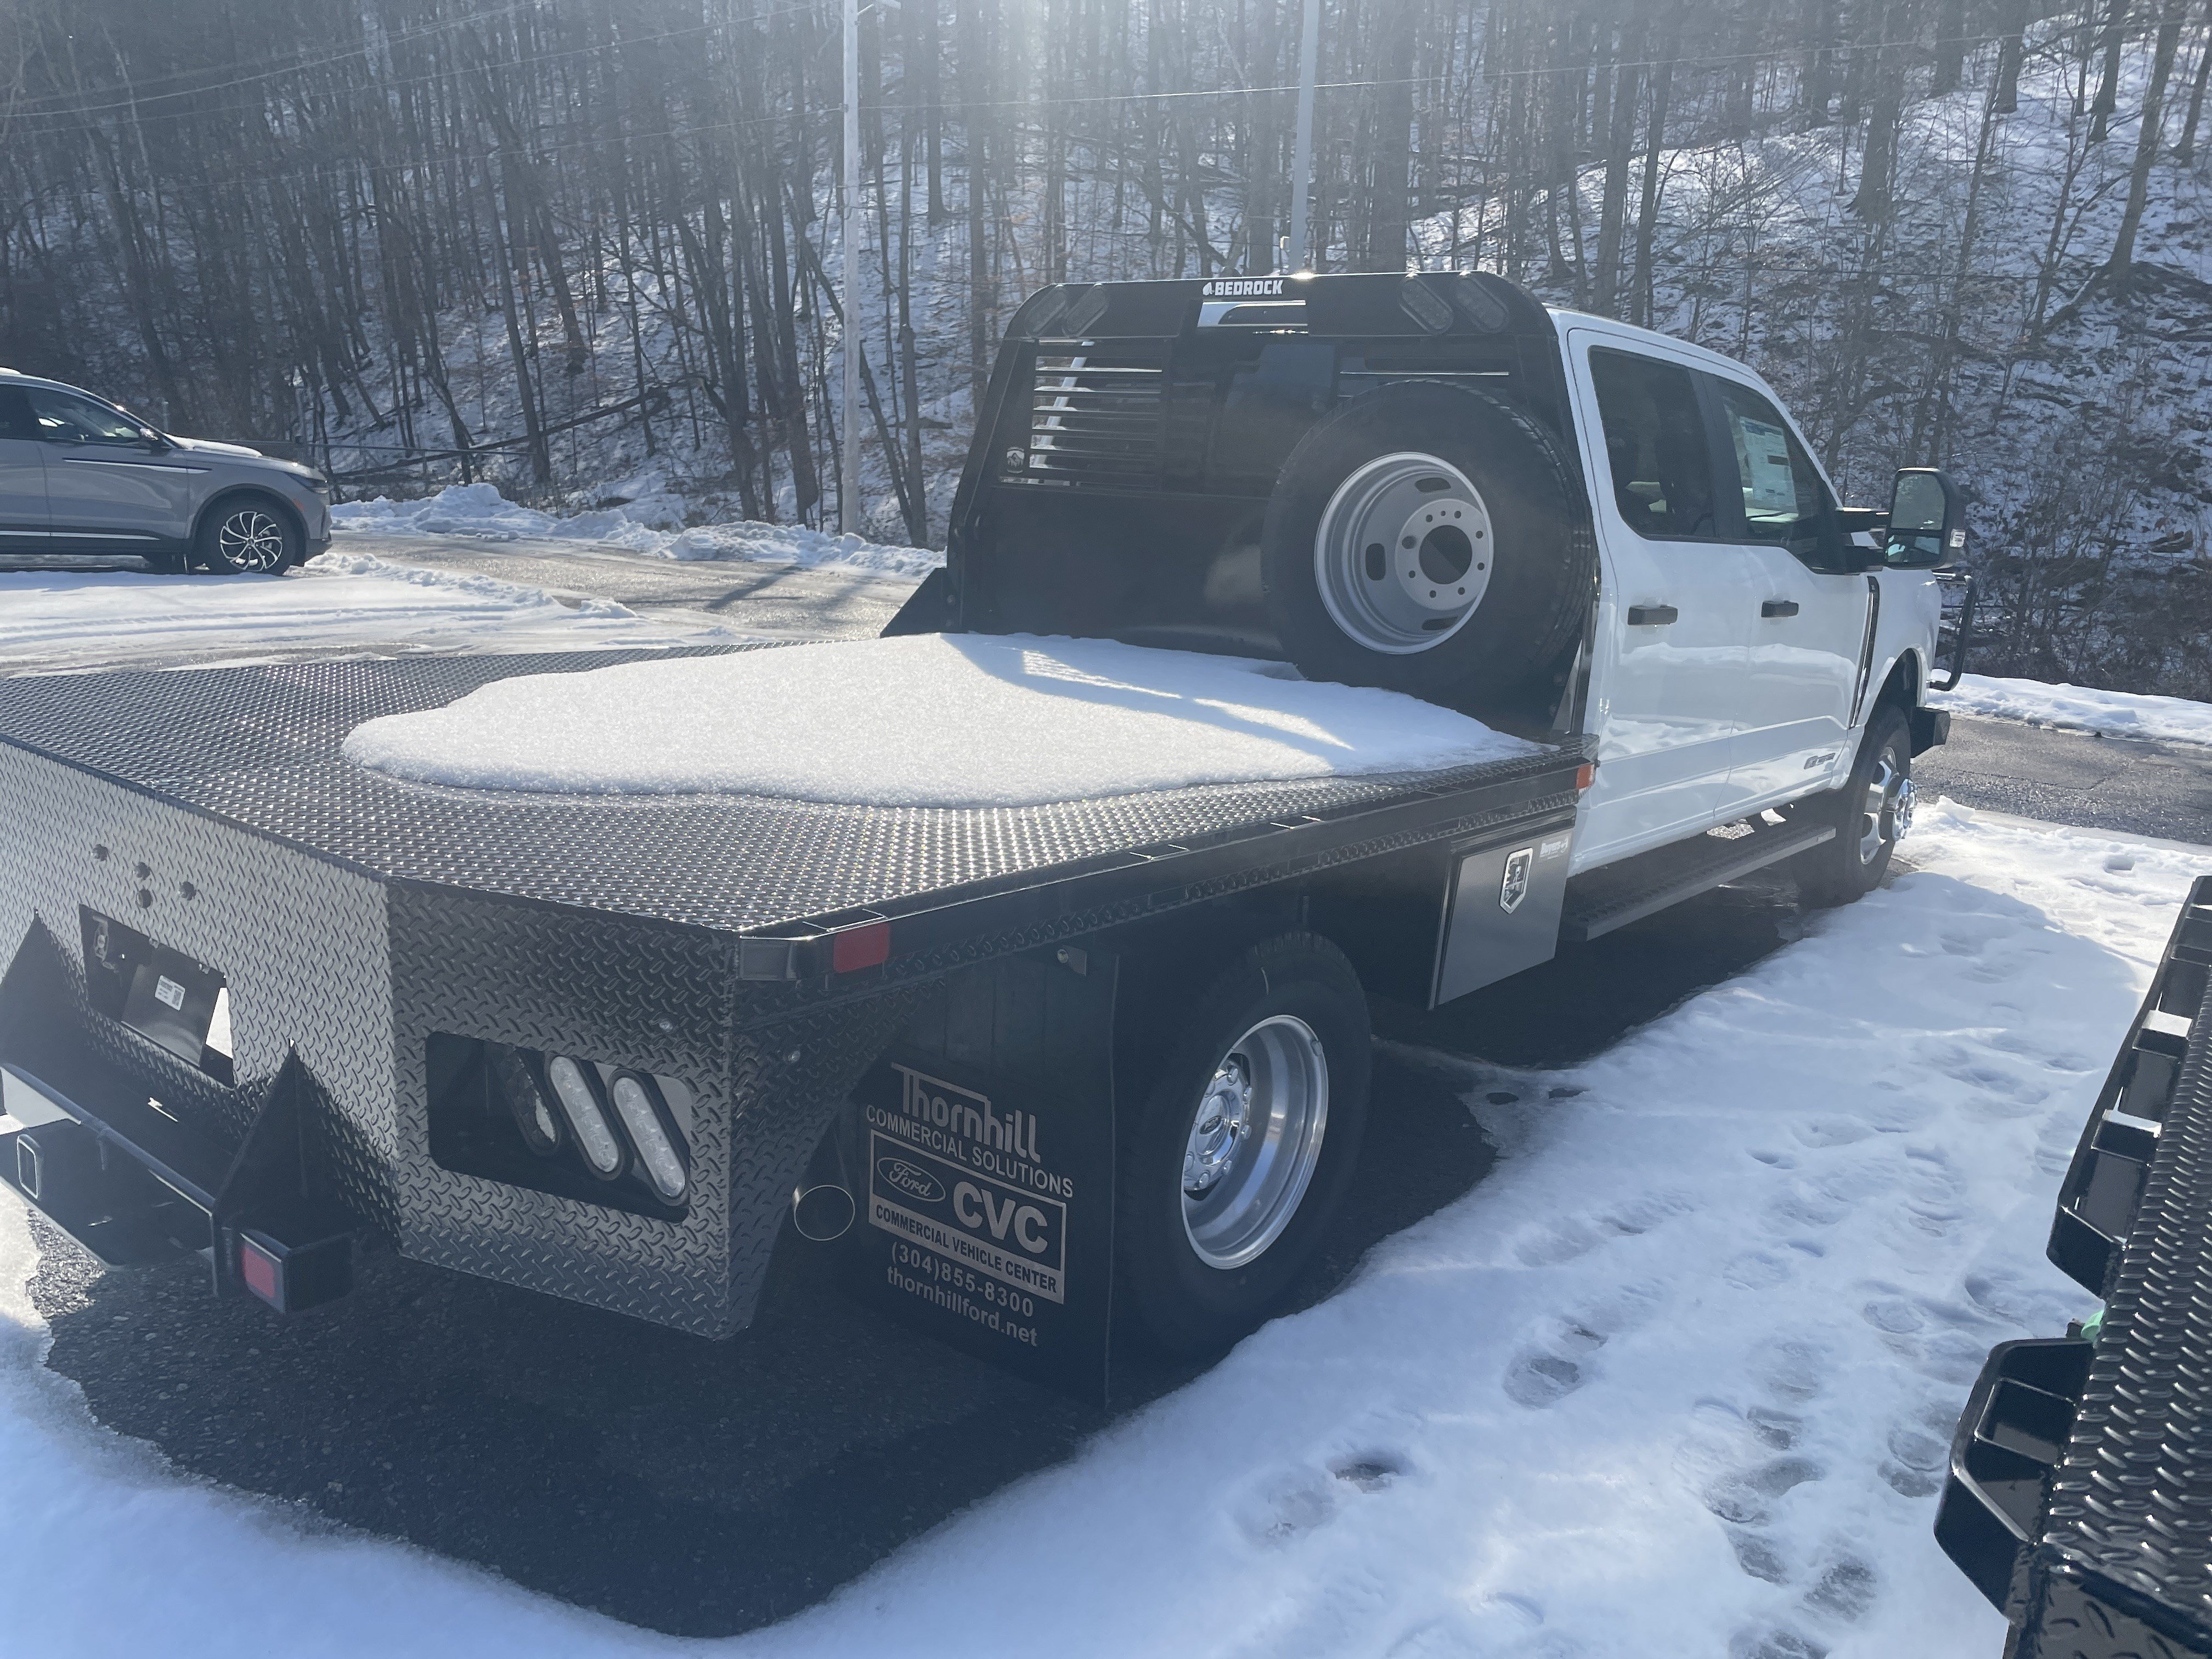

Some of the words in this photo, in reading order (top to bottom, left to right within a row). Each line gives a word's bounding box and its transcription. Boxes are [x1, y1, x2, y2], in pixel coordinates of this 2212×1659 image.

[1215, 280, 1283, 296] BEDROCK
[866, 1104, 967, 1161] COMMERCIAL
[972, 1146, 1073, 1198] SOLUTIONS
[891, 1062, 1041, 1163] Thornhill
[889, 1163, 932, 1196] Ford
[953, 1181, 1048, 1254] CVC
[876, 1204, 949, 1249] COMMERCIAL
[952, 1237, 1002, 1272] VEHICLE
[1006, 1261, 1056, 1293] CENTER
[892, 1241, 1033, 1317] (304)855-8300
[887, 1266, 1037, 1347] thornhillford.net
